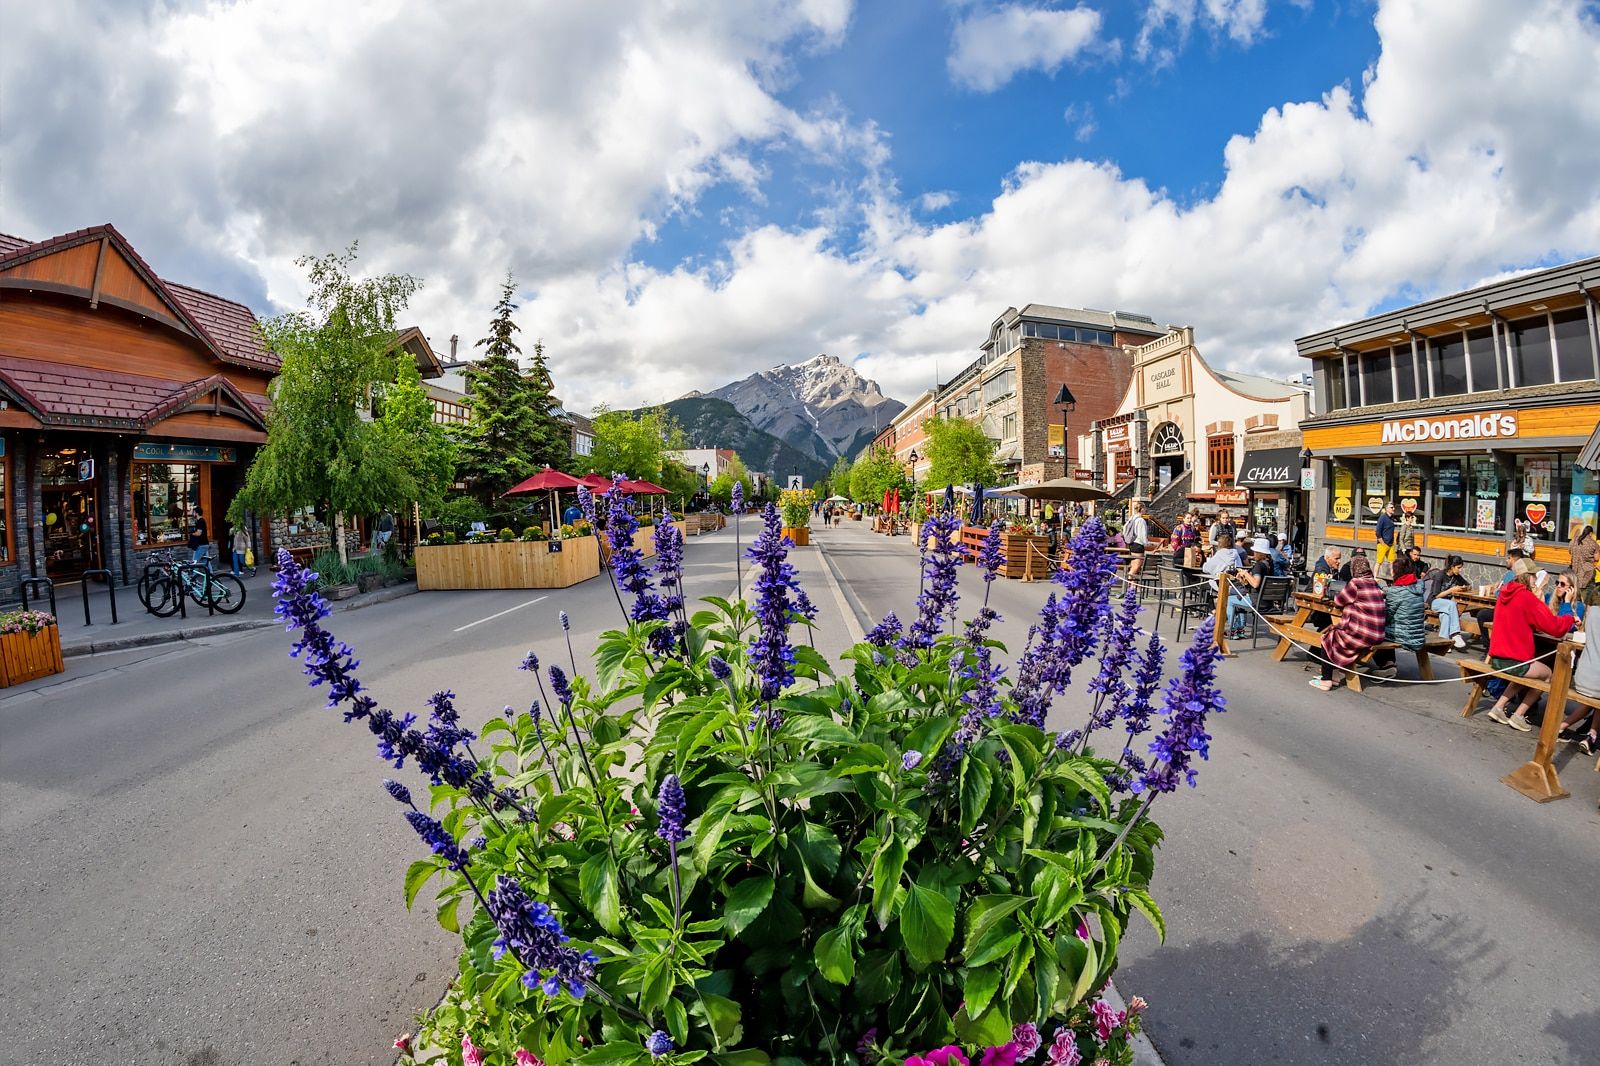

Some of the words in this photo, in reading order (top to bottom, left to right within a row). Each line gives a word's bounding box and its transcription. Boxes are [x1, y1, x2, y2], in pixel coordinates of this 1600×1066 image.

[1150, 367, 1176, 383] CASCADE
[1156, 379, 1172, 390] HALL
[1381, 413, 1517, 443] McDonald's
[1247, 466, 1289, 481] CHAYA
[1335, 506, 1350, 514] Mac
